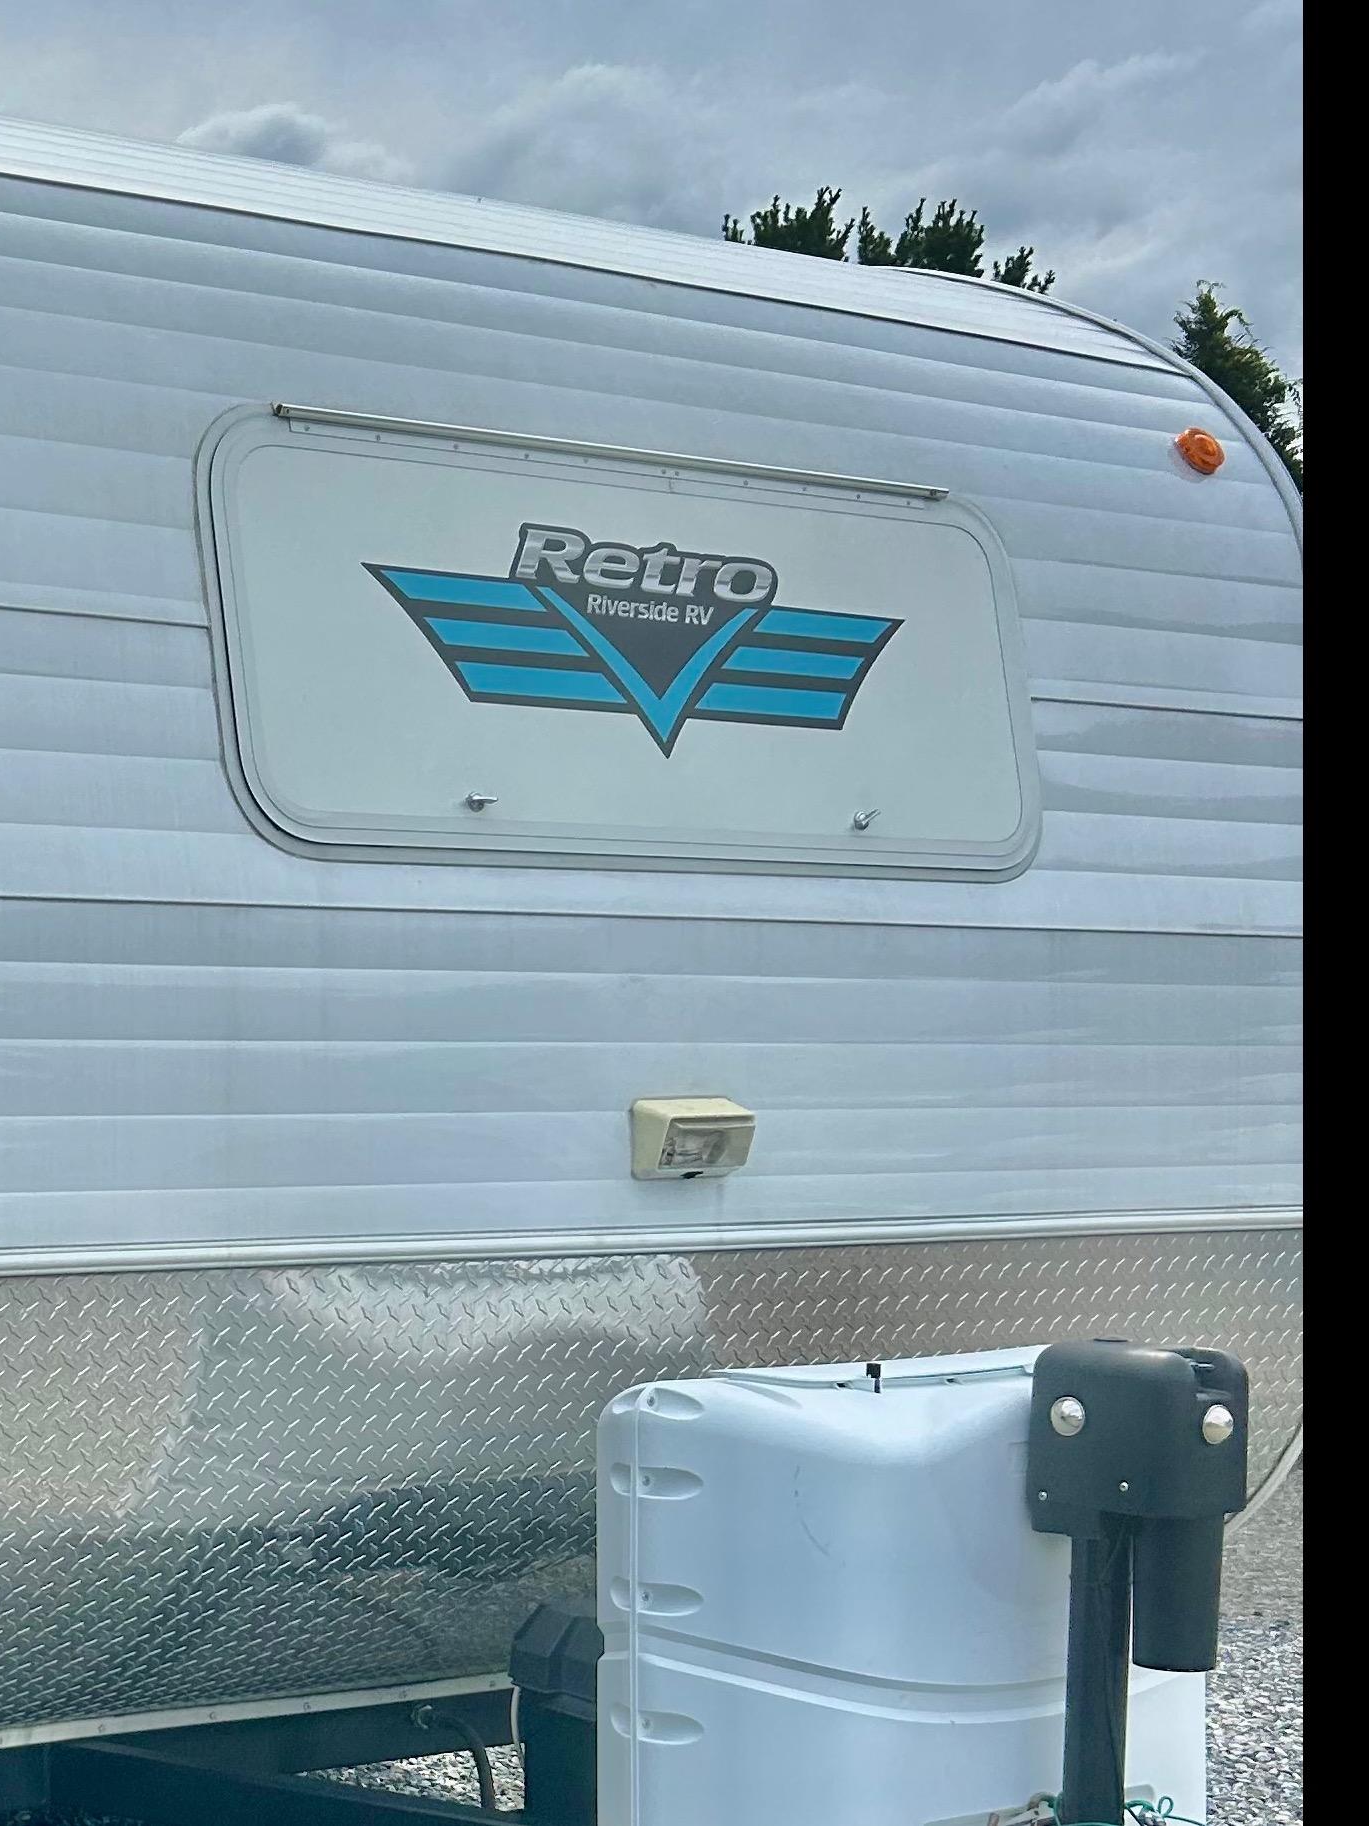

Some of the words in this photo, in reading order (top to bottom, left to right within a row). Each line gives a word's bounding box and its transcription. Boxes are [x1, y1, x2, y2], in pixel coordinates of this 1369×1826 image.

[516, 529, 773, 602] Retro
[587, 593, 680, 623] Riverside
[684, 604, 715, 626] RV
